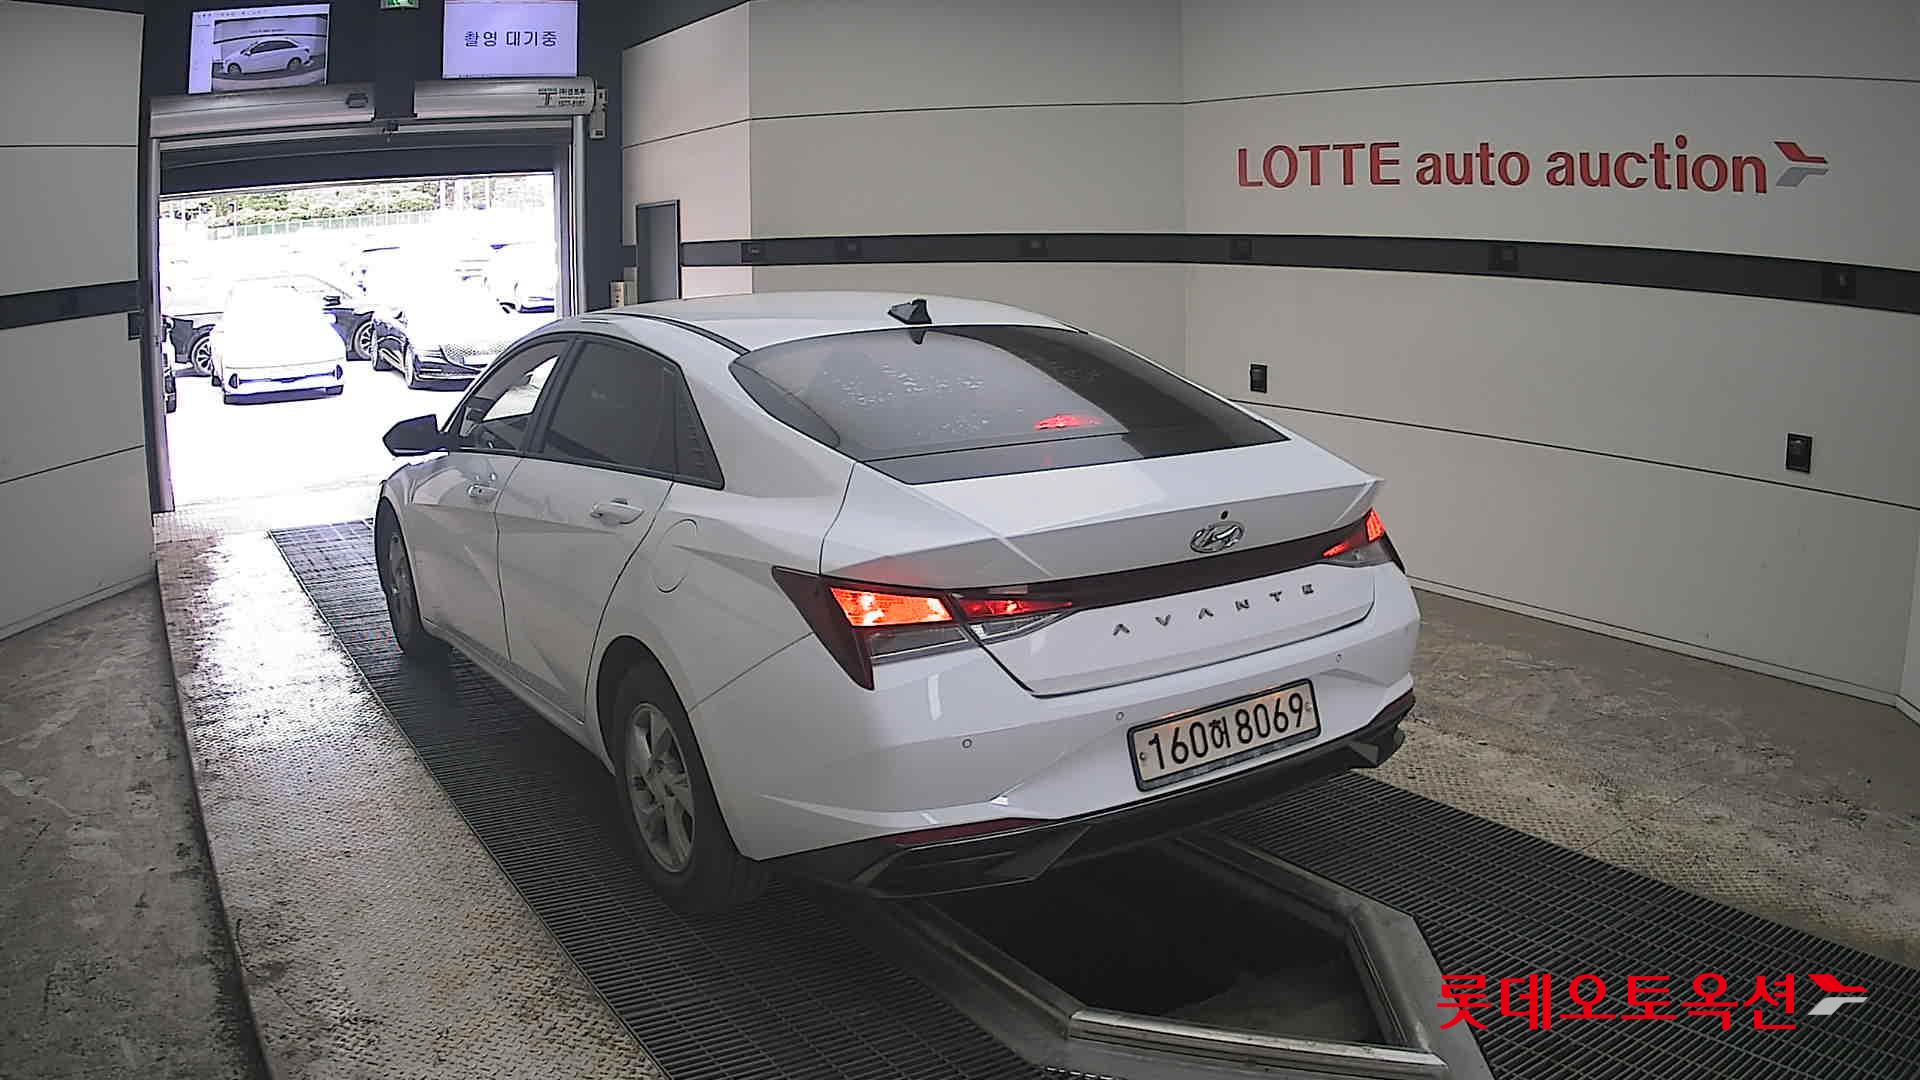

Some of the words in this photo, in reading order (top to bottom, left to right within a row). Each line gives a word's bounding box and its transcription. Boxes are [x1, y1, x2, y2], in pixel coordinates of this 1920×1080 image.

[463, 30, 498, 48] 촬영
[505, 31, 558, 48] 대기중
[1237, 142, 1400, 188] LOTTE
[1416, 141, 1531, 186] auto
[1545, 135, 1768, 194] auction
[1112, 583, 1315, 637] AVANTE
